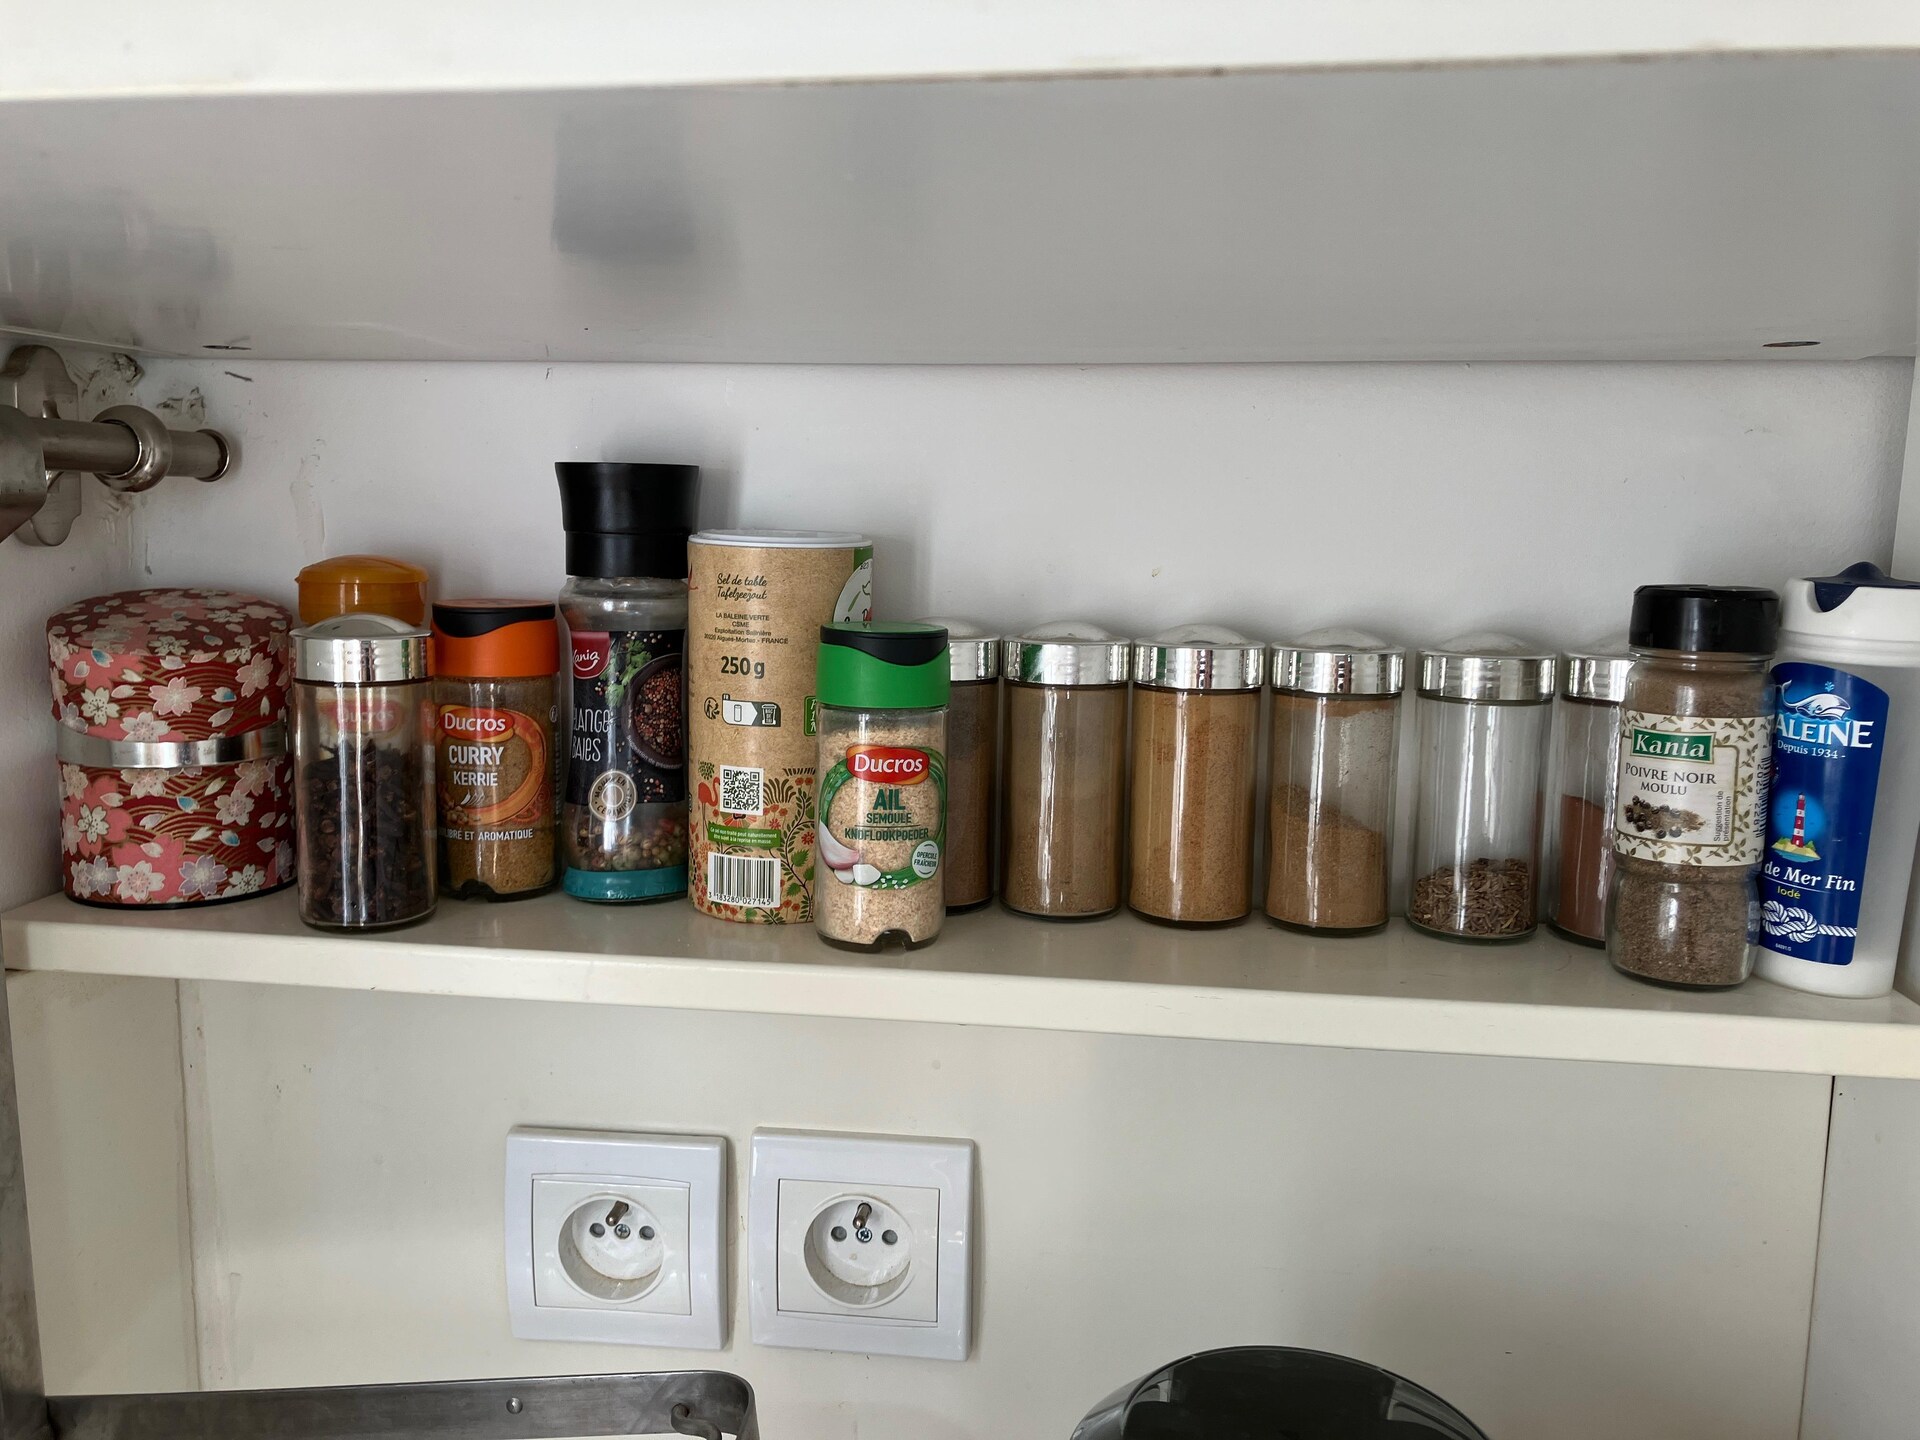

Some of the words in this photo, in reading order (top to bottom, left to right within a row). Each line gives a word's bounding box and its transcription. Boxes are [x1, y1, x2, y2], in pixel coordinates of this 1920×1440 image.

[717, 572, 731, 585] Sel
[731, 574, 742, 586] de
[744, 575, 767, 587] table
[717, 586, 768, 602] Tafelzeezout
[761, 637, 789, 645] FRANCE
[720, 655, 751, 675] 250
[754, 662, 765, 679] g
[444, 712, 506, 732] Ducros
[1775, 713, 1875, 749] ALEINE
[448, 744, 505, 766] CURRY
[1635, 733, 1705, 758] Kania
[1777, 739, 1808, 755] Depuis
[1811, 747, 1838, 759] 1934
[854, 754, 923, 773] Ducros
[453, 771, 498, 786] KERRIE
[1625, 762, 1668, 781] POIVRE
[1673, 771, 1717, 785] NOIR
[1639, 781, 1687, 796] MOULU
[1716, 790, 1724, 801] de
[872, 788, 906, 811] AIL
[866, 812, 912, 824] SEMOULE
[1713, 802, 1723, 842] Suggestion
[1722, 796, 1731, 842] présentation
[464, 830, 475, 841] ET
[478, 829, 534, 841] AROMATIQUE
[844, 827, 929, 842] KNOFLOOKPOEDER
[1764, 861, 1780, 877] de
[1783, 866, 1821, 887] Mer
[1825, 874, 1856, 892] Fin
[708, 891, 712, 899] 3
[742, 897, 771, 906] 027145
[1777, 885, 1801, 899] Iodé
